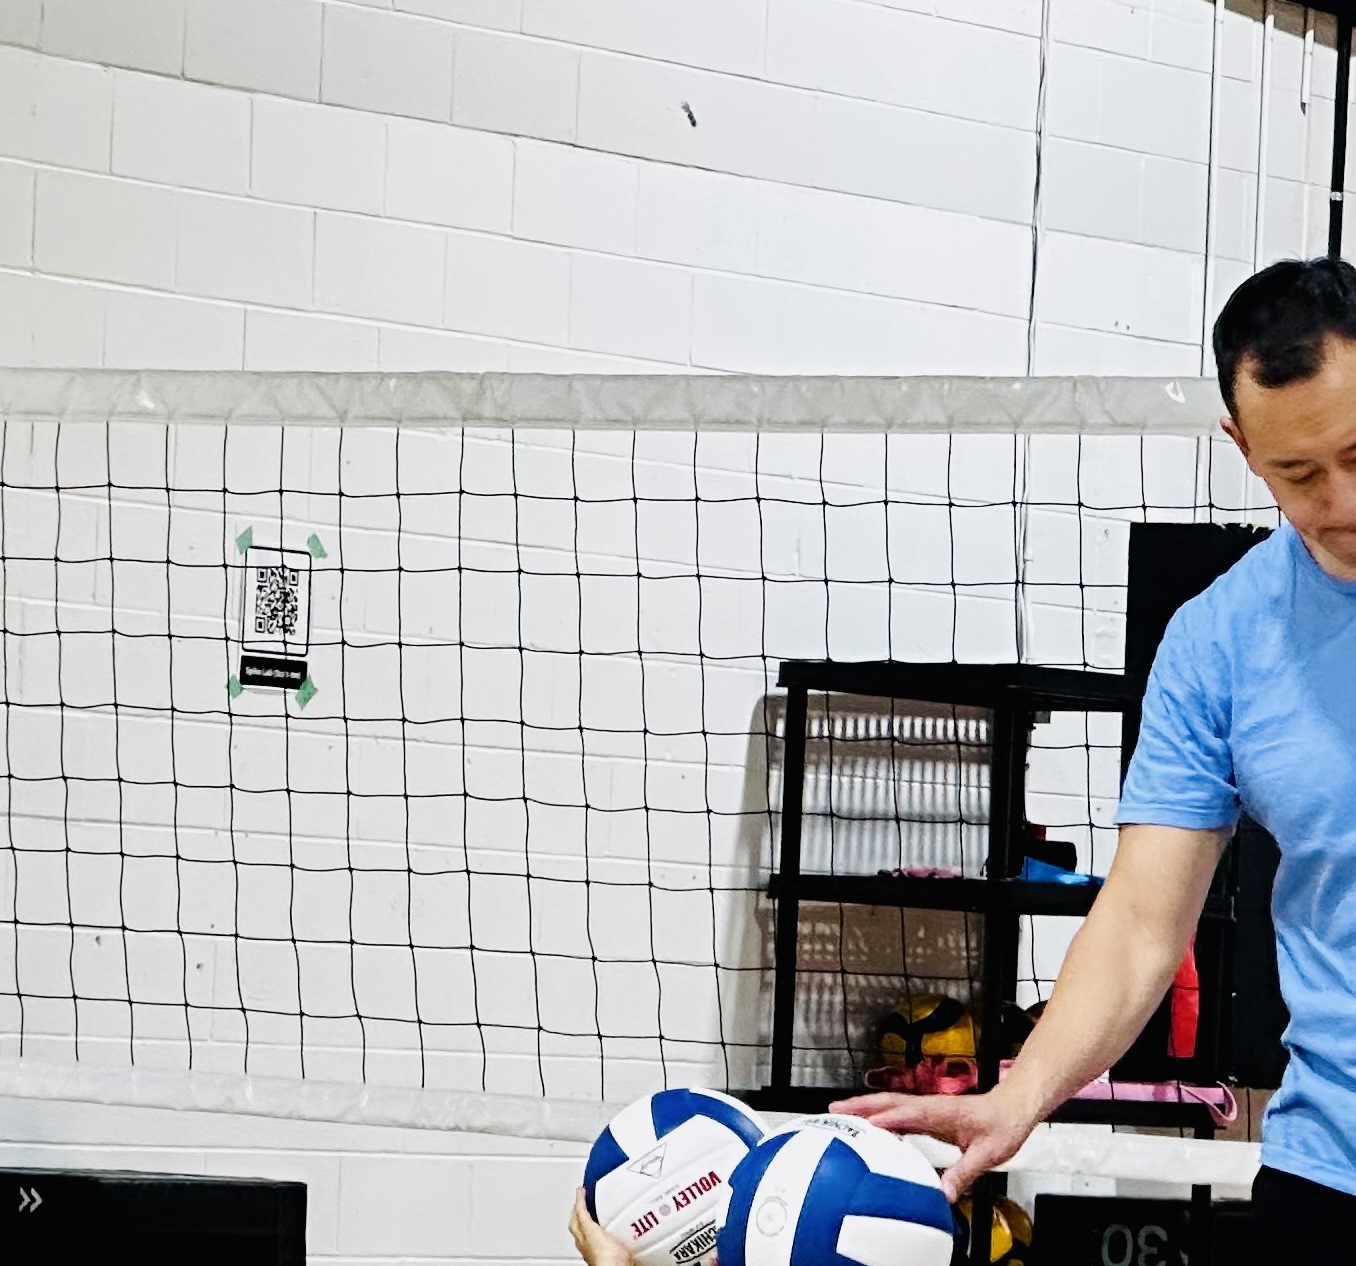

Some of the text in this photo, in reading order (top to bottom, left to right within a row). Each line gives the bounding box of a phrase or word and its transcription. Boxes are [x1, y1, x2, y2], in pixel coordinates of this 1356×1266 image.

[672, 1171, 722, 1212] VOLLEY
[630, 1211, 660, 1237] LITE
[673, 1226, 717, 1261] CHIKARA
